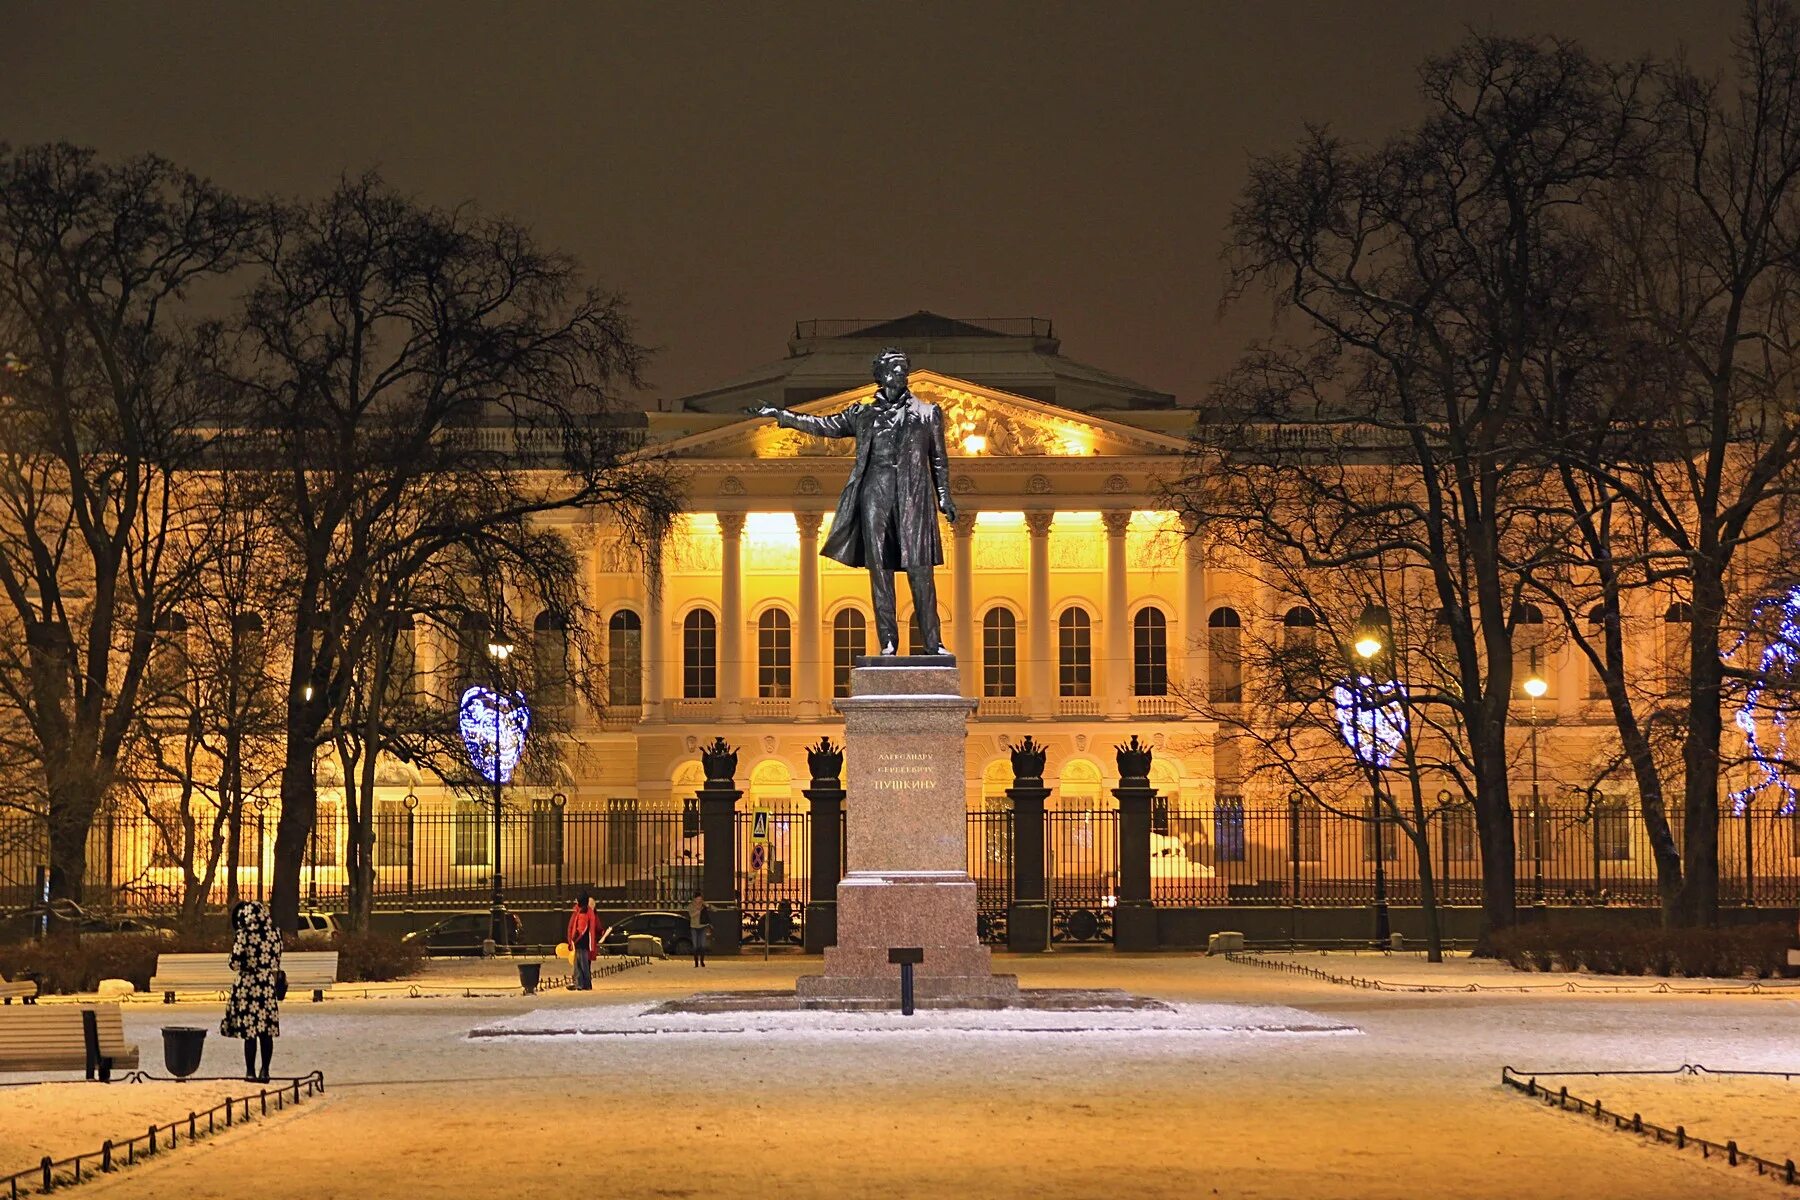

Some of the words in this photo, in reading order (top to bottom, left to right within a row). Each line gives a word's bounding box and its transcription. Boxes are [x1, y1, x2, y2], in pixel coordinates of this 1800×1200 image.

[878, 753, 933, 761] АЛЕКСАНДРУ
[877, 766, 933, 774] СЕРГЕЕВИЧУ
[874, 780, 937, 790] ПУШКИНУ
